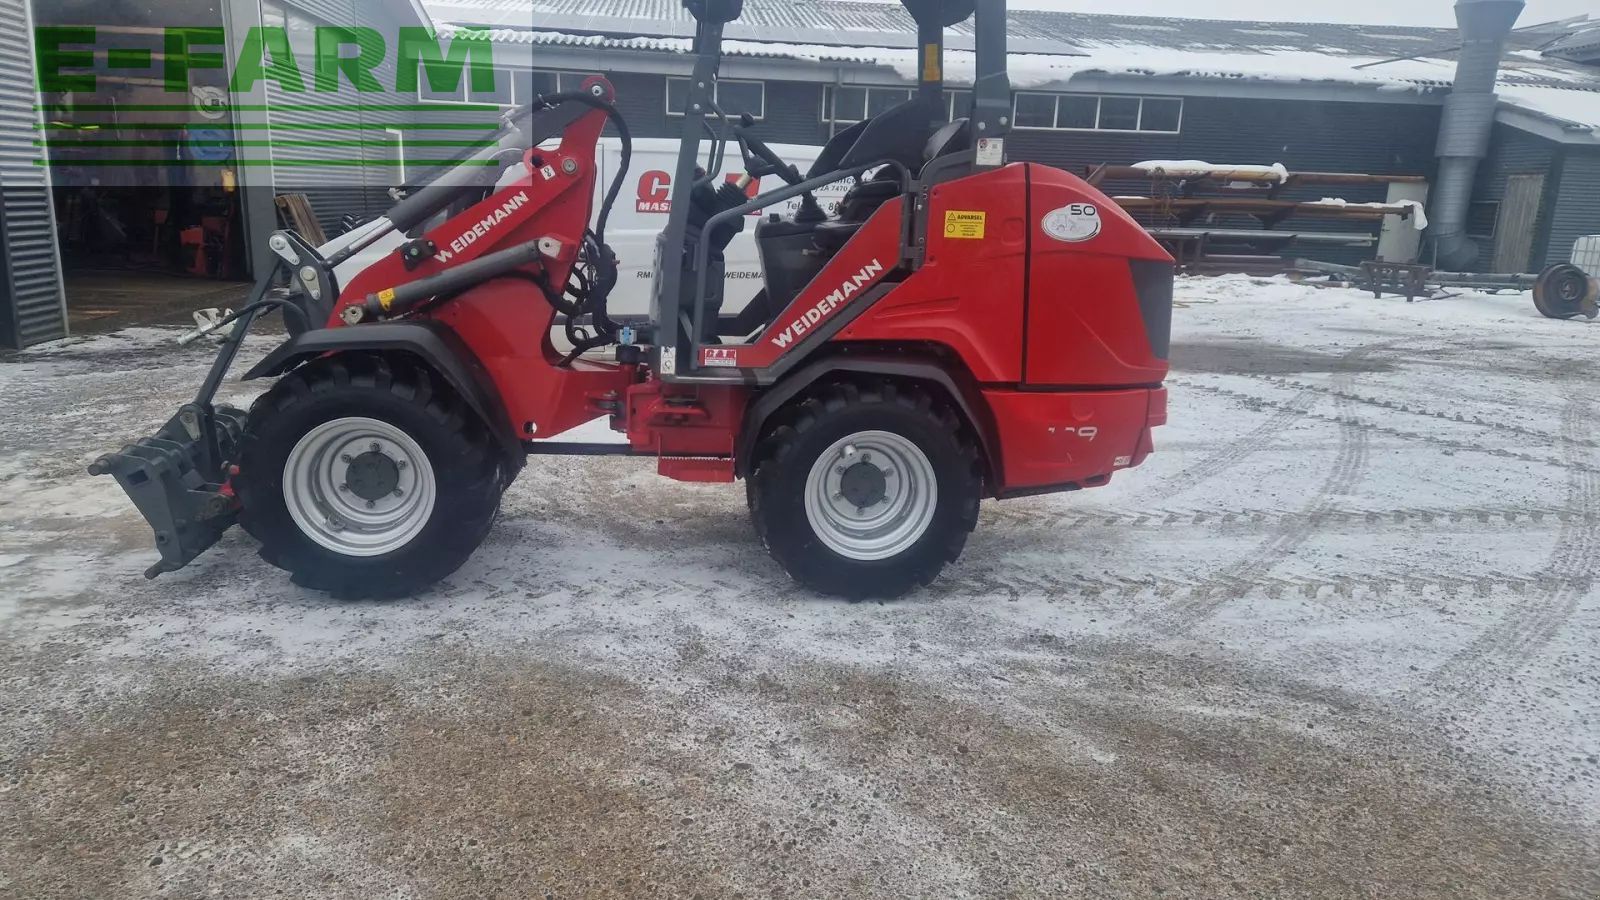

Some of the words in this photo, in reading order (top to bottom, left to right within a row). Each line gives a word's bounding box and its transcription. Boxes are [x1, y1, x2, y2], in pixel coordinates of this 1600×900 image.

[433, 190, 530, 264] WEIDEMANN
[1070, 205, 1096, 216] 50
[771, 258, 883, 348] WEIDEMANN
